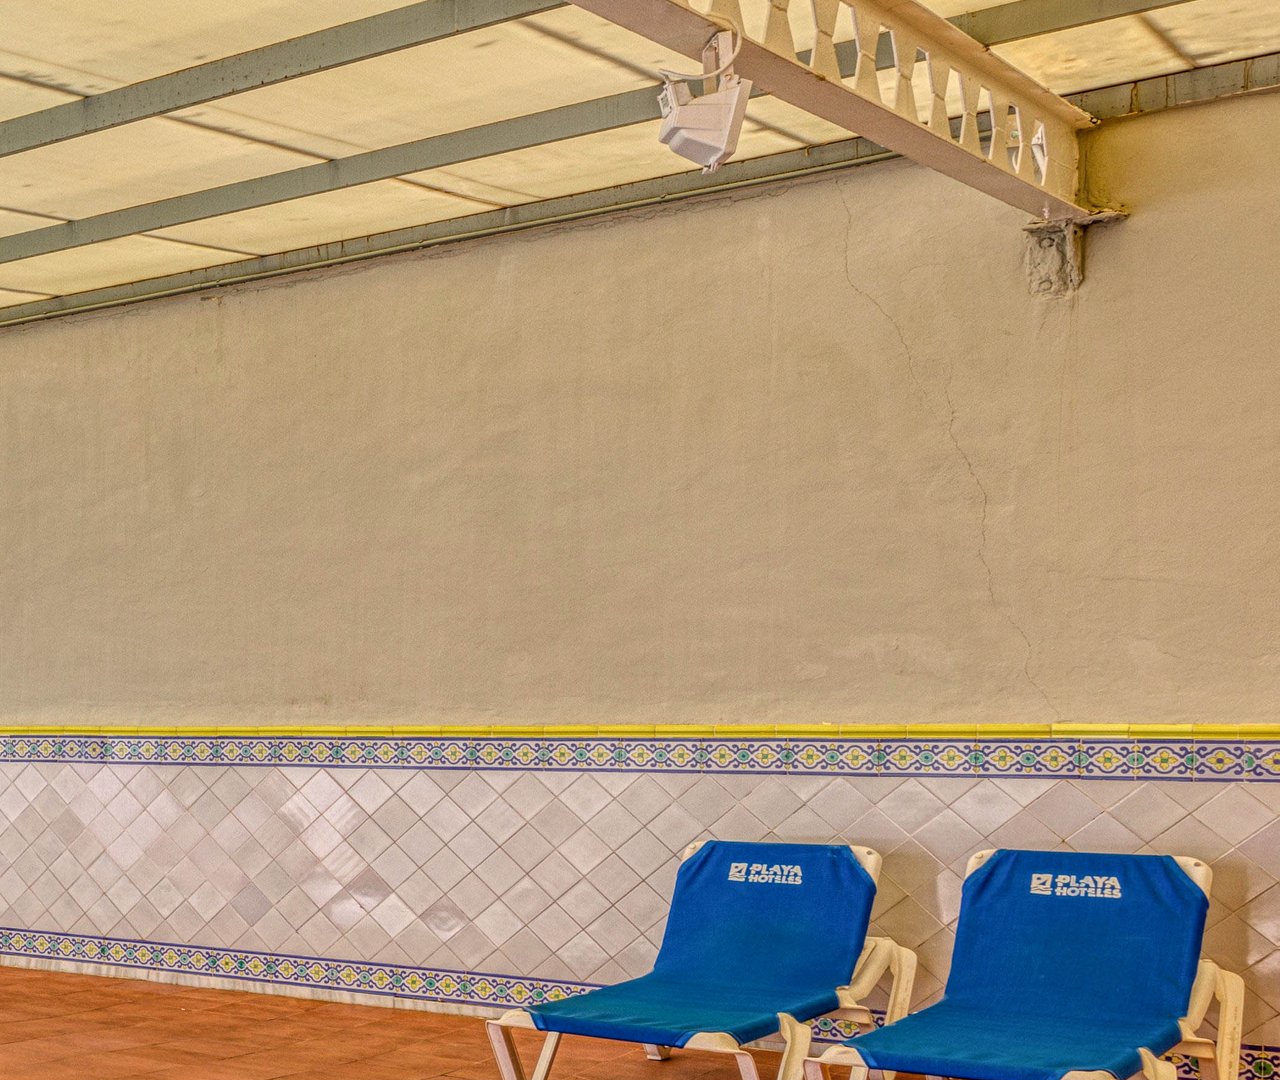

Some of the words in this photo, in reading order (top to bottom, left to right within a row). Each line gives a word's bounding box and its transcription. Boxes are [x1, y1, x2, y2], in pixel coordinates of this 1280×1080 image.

[749, 864, 802, 876] PLAYA
[748, 875, 802, 884] HOTELES
[1055, 875, 1121, 888] PLAYA
[1055, 887, 1122, 898] HOTELES
